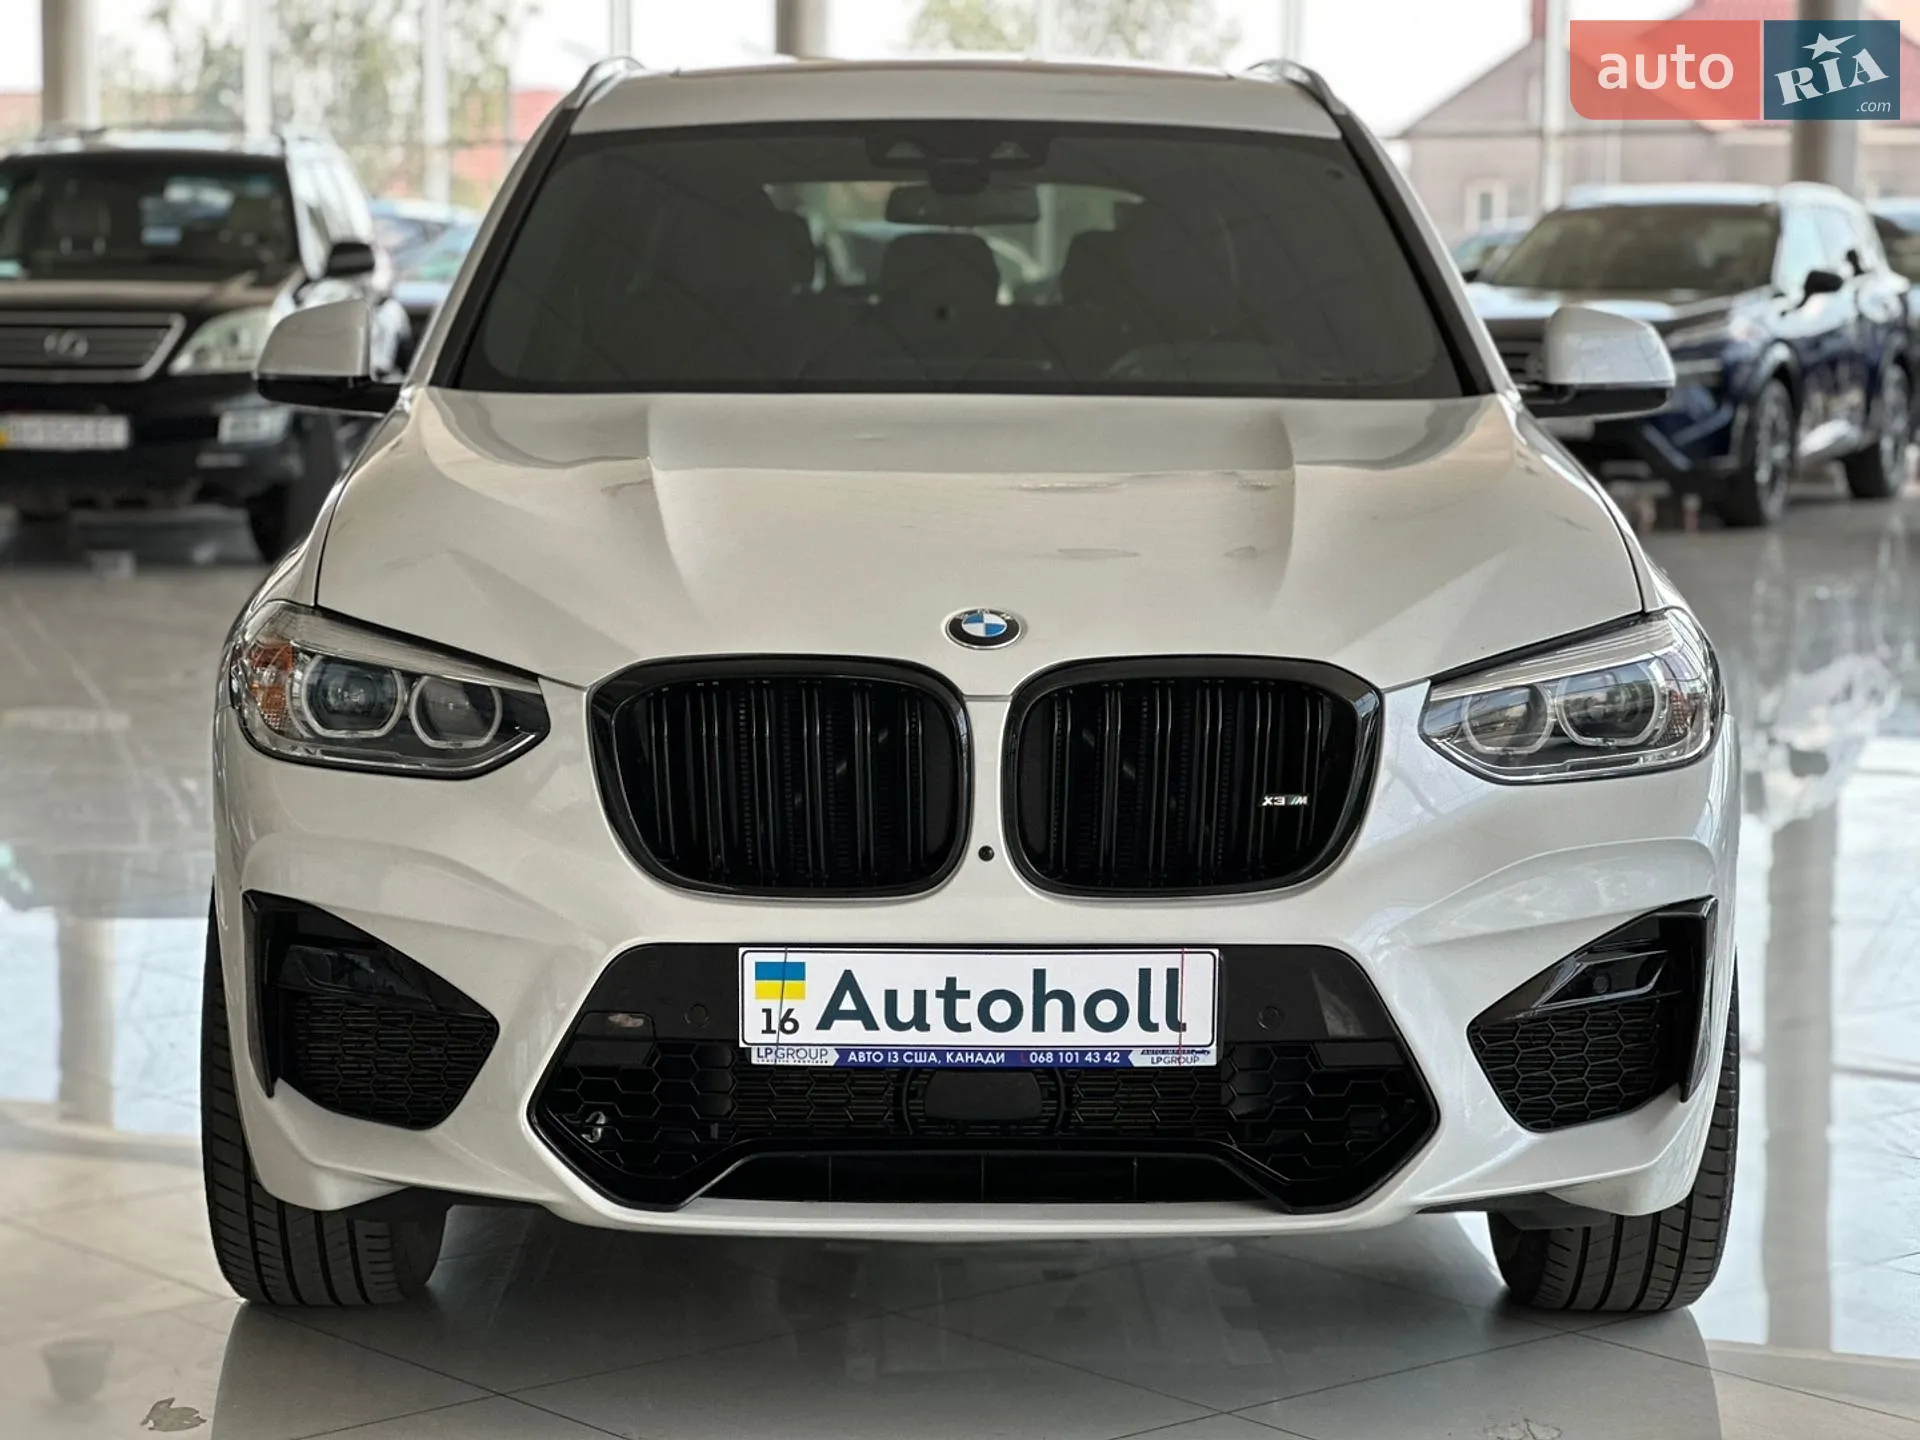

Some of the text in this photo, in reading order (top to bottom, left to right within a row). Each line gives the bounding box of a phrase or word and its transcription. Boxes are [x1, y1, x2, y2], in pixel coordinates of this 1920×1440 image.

[1262, 796, 1285, 806] X3
[816, 967, 1187, 1033] Autoholl
[761, 1008, 800, 1035] 16
[847, 1051, 884, 1063] АВТО
[903, 1051, 942, 1064] США,
[946, 1051, 1006, 1064] КАНАДИ
[1029, 1051, 1054, 1064] 068
[1058, 1051, 1080, 1064] 101
[1084, 1051, 1101, 1064] 43
[1104, 1051, 1121, 1064] 42
